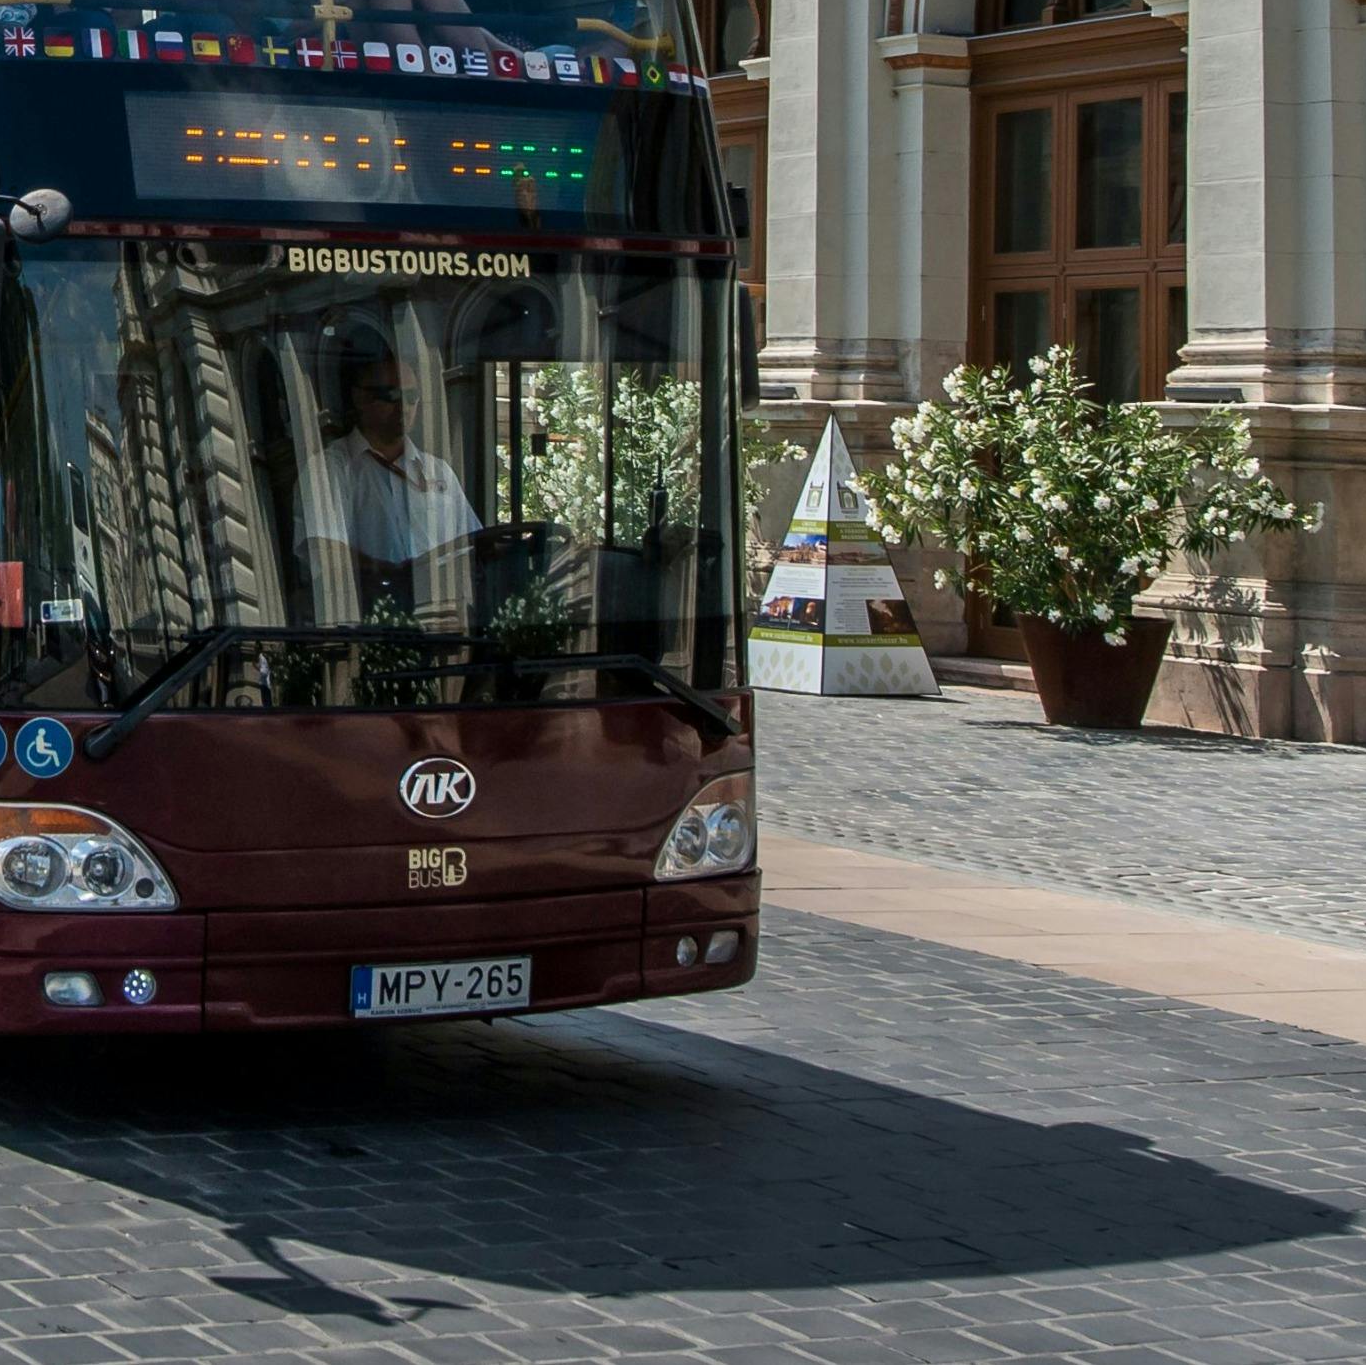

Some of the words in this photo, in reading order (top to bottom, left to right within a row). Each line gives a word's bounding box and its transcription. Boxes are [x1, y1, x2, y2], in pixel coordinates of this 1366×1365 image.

[288, 247, 531, 278] BIGBUSTOURS.COM
[408, 847, 441, 869] BIG
[408, 869, 442, 889] BUS
[378, 963, 524, 1006] MPY-265
[357, 992, 367, 1005] H
